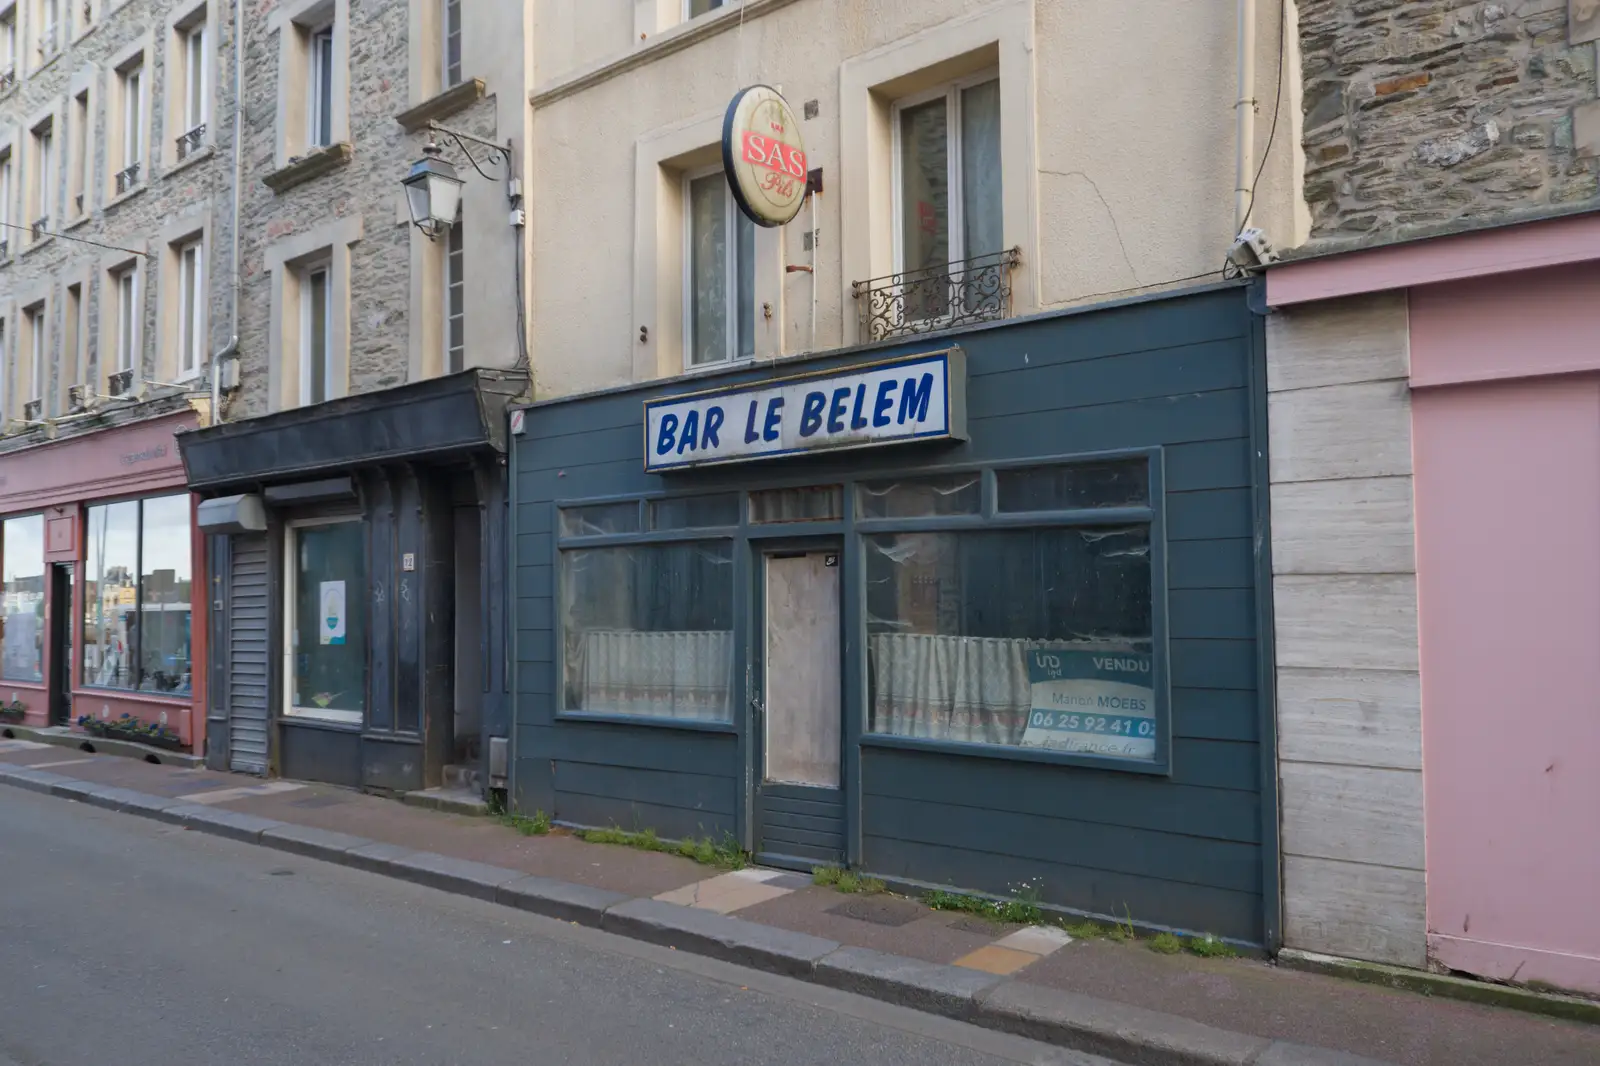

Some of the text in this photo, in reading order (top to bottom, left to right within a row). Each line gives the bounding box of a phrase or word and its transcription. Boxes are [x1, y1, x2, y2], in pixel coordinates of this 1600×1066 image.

[748, 134, 804, 177] SAS
[760, 171, 793, 198] Pils
[656, 372, 934, 455] BAR LE BELEM
[1092, 656, 1150, 672] VENDU
[1052, 692, 1146, 711] Manon MOEBS
[1033, 711, 1053, 727] 06
[1058, 714, 1079, 729] 25
[1084, 716, 1105, 731] 92
[1110, 719, 1132, 735] 41
